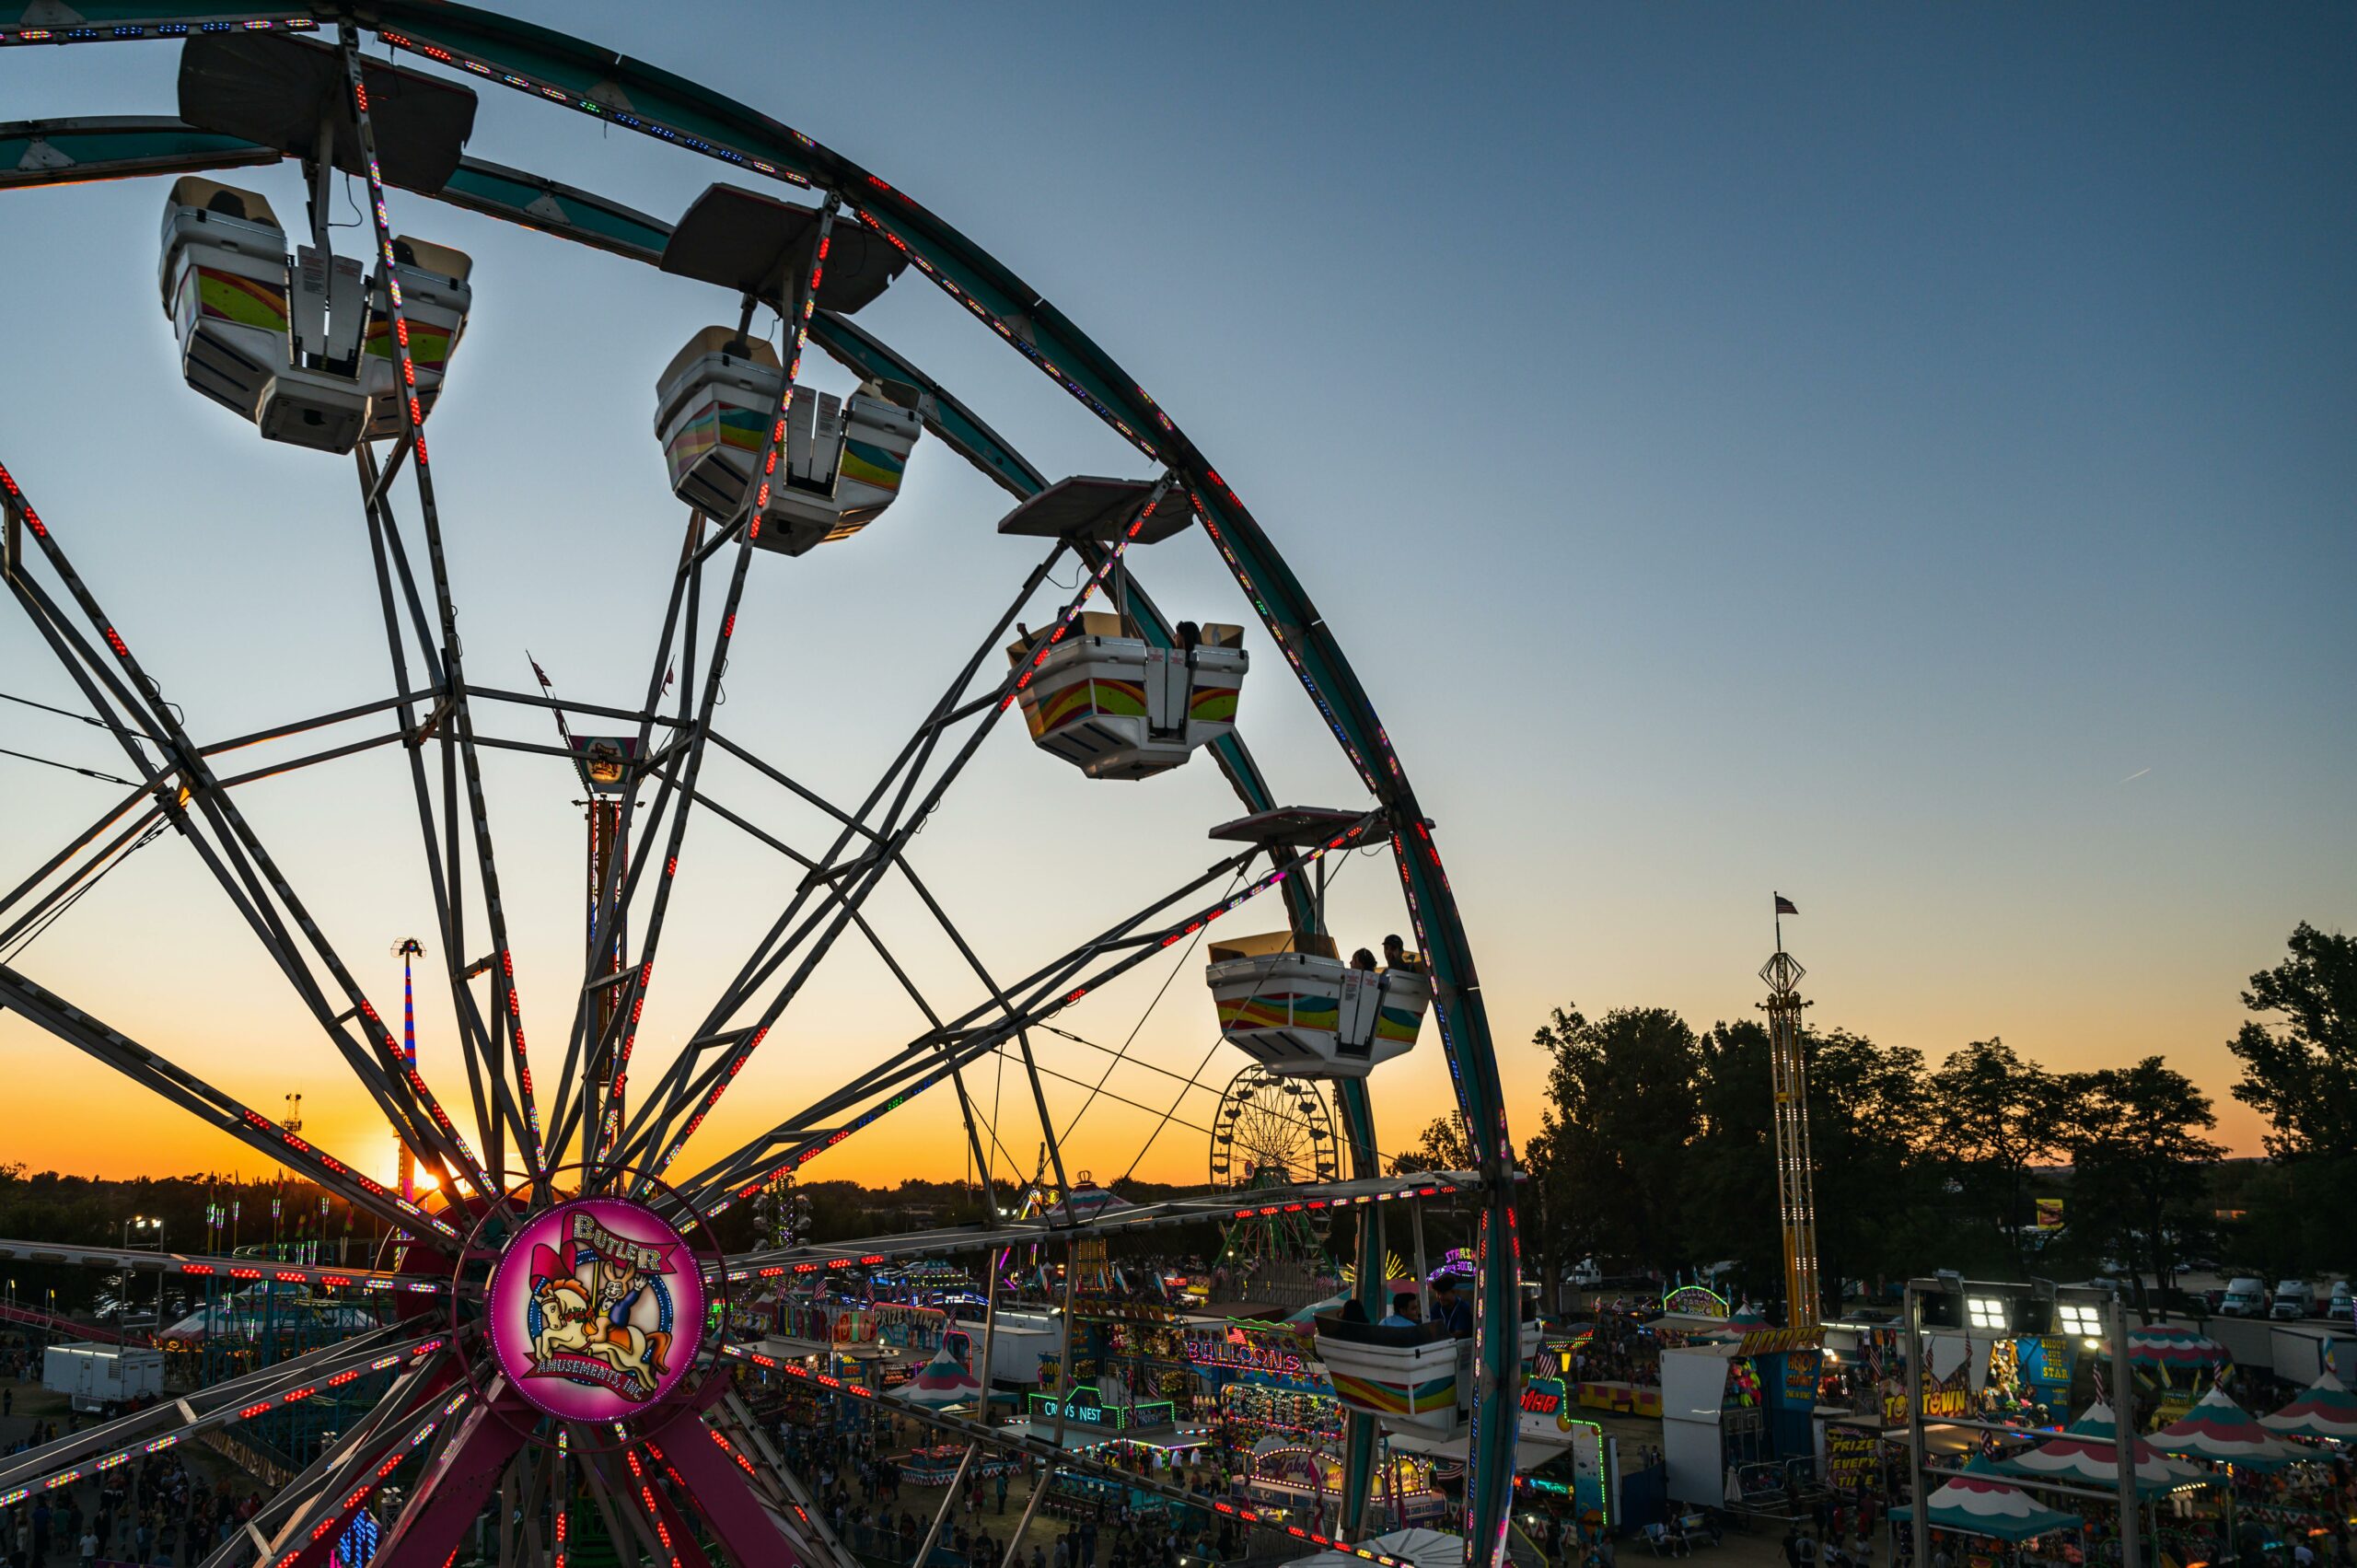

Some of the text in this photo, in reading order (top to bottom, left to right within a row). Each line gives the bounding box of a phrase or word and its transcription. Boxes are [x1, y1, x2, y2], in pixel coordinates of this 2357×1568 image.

[573, 1214, 661, 1272] BUTLER
[1675, 1289, 1717, 1305] BALLOON
[839, 1311, 871, 1342] BIG
[875, 1307, 943, 1334] PRIZE TIME
[1736, 1326, 1828, 1356] HOOPS
[2041, 1338, 2067, 1350] SHOOT
[1188, 1342, 1301, 1372] BALLOONS
[1787, 1353, 1817, 1373] HOOP
[2048, 1358, 2062, 1367] THE
[536, 1358, 621, 1389] AMUSEMENTS,
[1786, 1375, 1814, 1388] SHOT
[2042, 1366, 2068, 1379] STAR
[1079, 1406, 1101, 1422] NEST
[1885, 1389, 1967, 1419] TO TOWN
[1832, 1437, 1876, 1453] PRIZE
